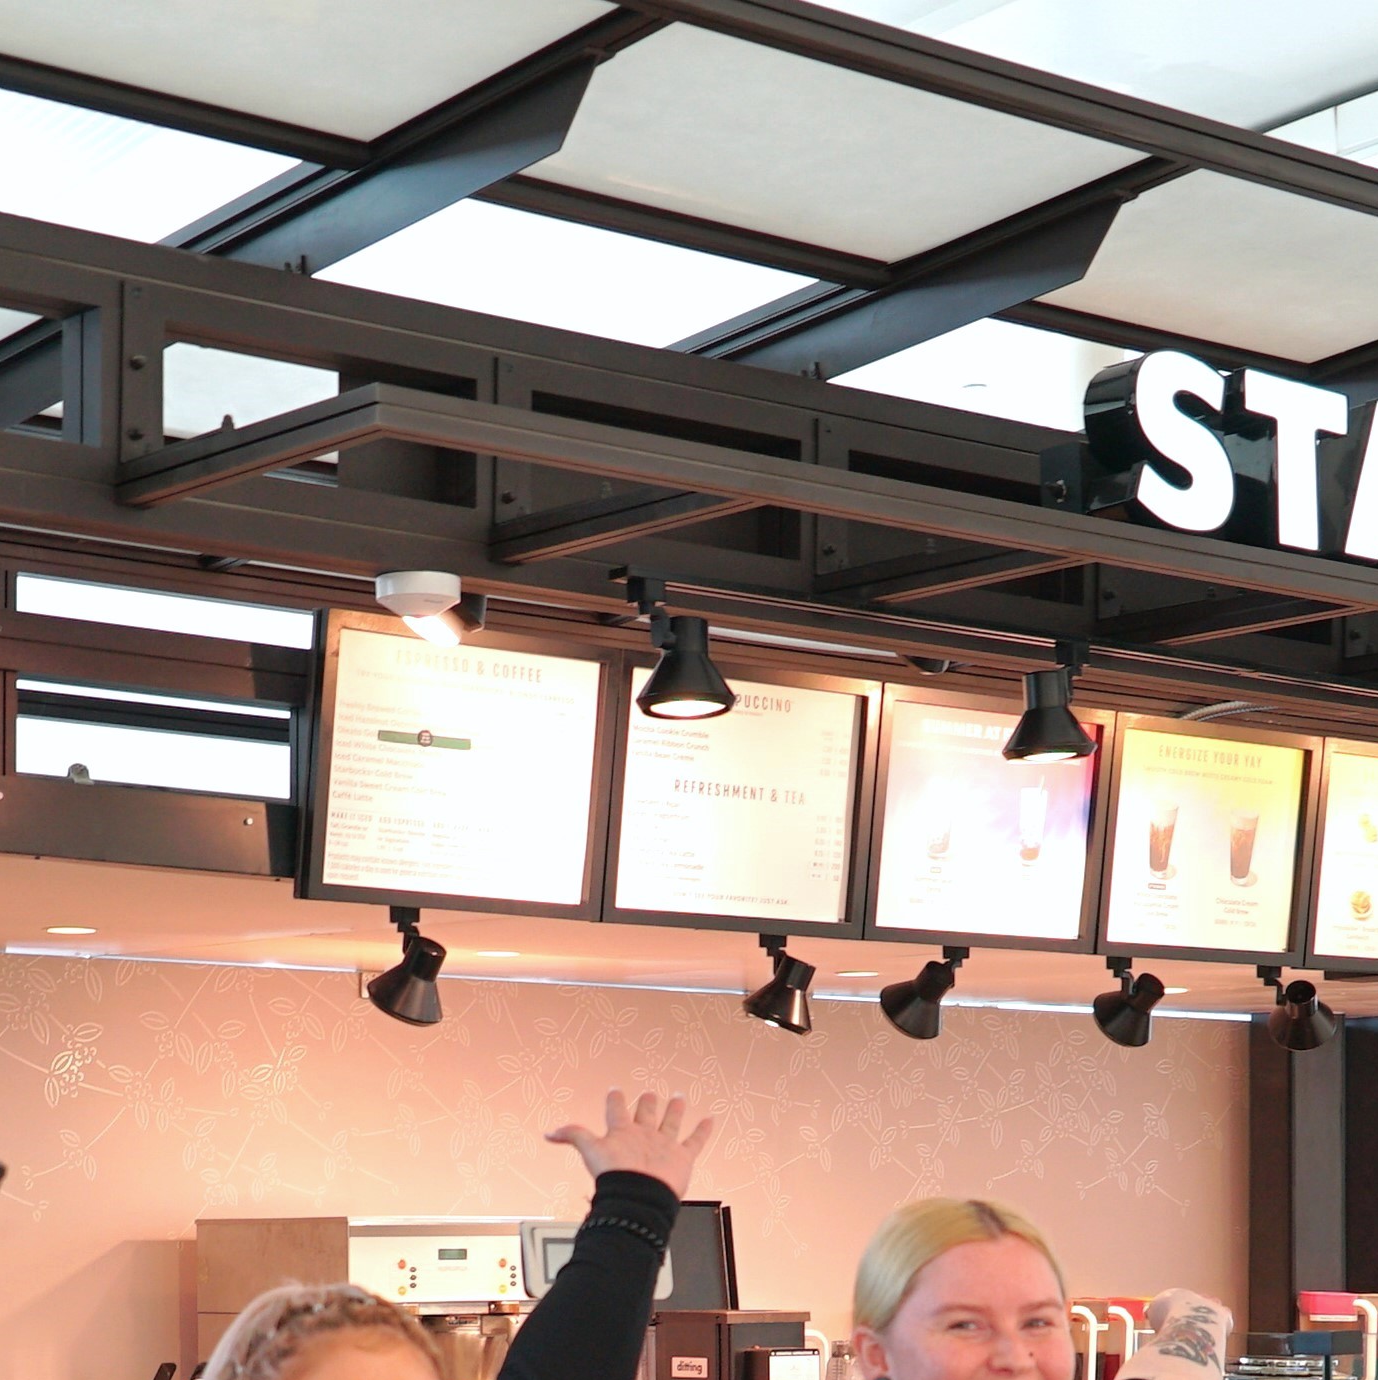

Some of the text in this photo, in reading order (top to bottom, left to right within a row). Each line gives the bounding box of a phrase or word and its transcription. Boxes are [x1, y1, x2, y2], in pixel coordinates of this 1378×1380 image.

[396, 649, 543, 684] ESPRESSO & COFFEE
[734, 694, 792, 713] PUCCINO
[1158, 744, 1209, 763] ENERGIZE
[1214, 750, 1239, 768] YOUR
[673, 778, 806, 805] REFRESHMENT & TEA
[676, 1360, 703, 1375] ditting
